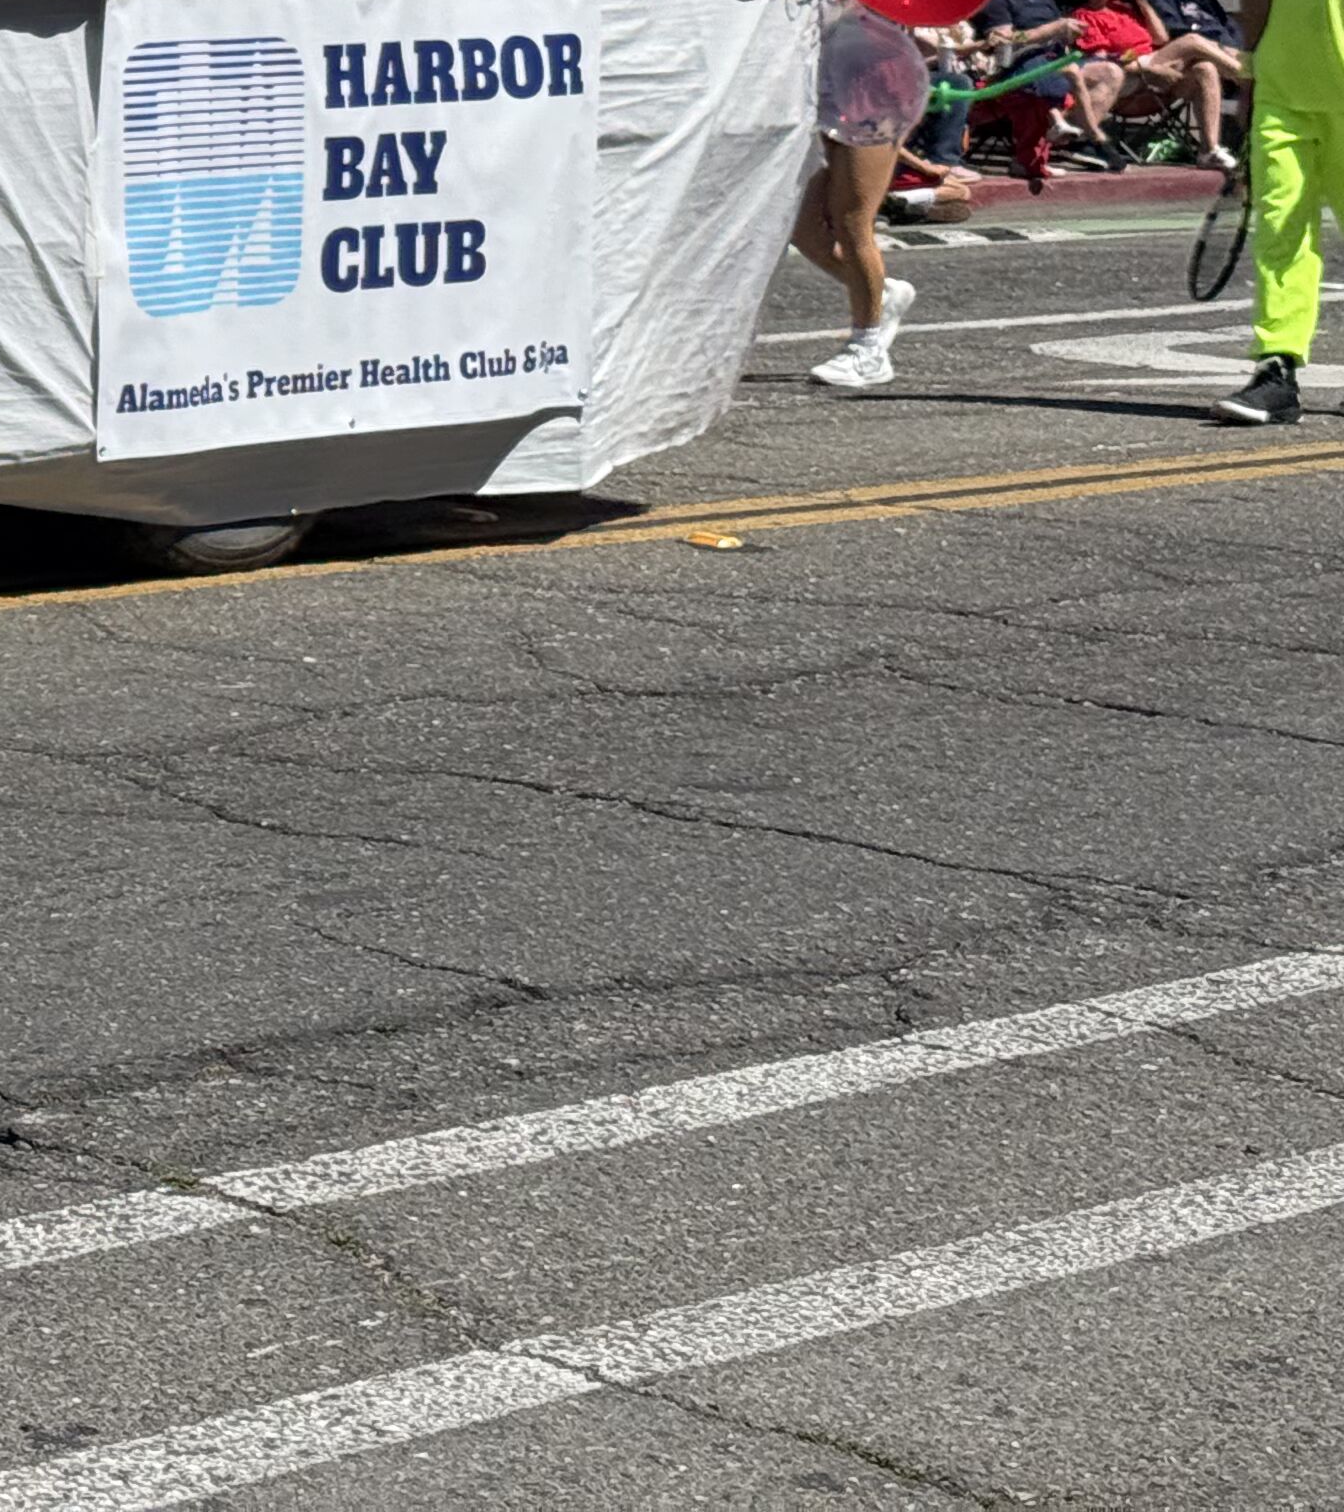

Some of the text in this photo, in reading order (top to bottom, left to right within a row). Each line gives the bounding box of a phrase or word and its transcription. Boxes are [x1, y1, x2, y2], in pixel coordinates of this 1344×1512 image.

[323, 34, 584, 109] HARBOR
[322, 130, 448, 202] BAY
[320, 219, 487, 293] CLUB
[116, 373, 240, 413] Alameda's
[246, 364, 352, 400] Premier
[359, 354, 450, 388] Health
[459, 348, 517, 380] Club
[523, 345, 537, 373] &
